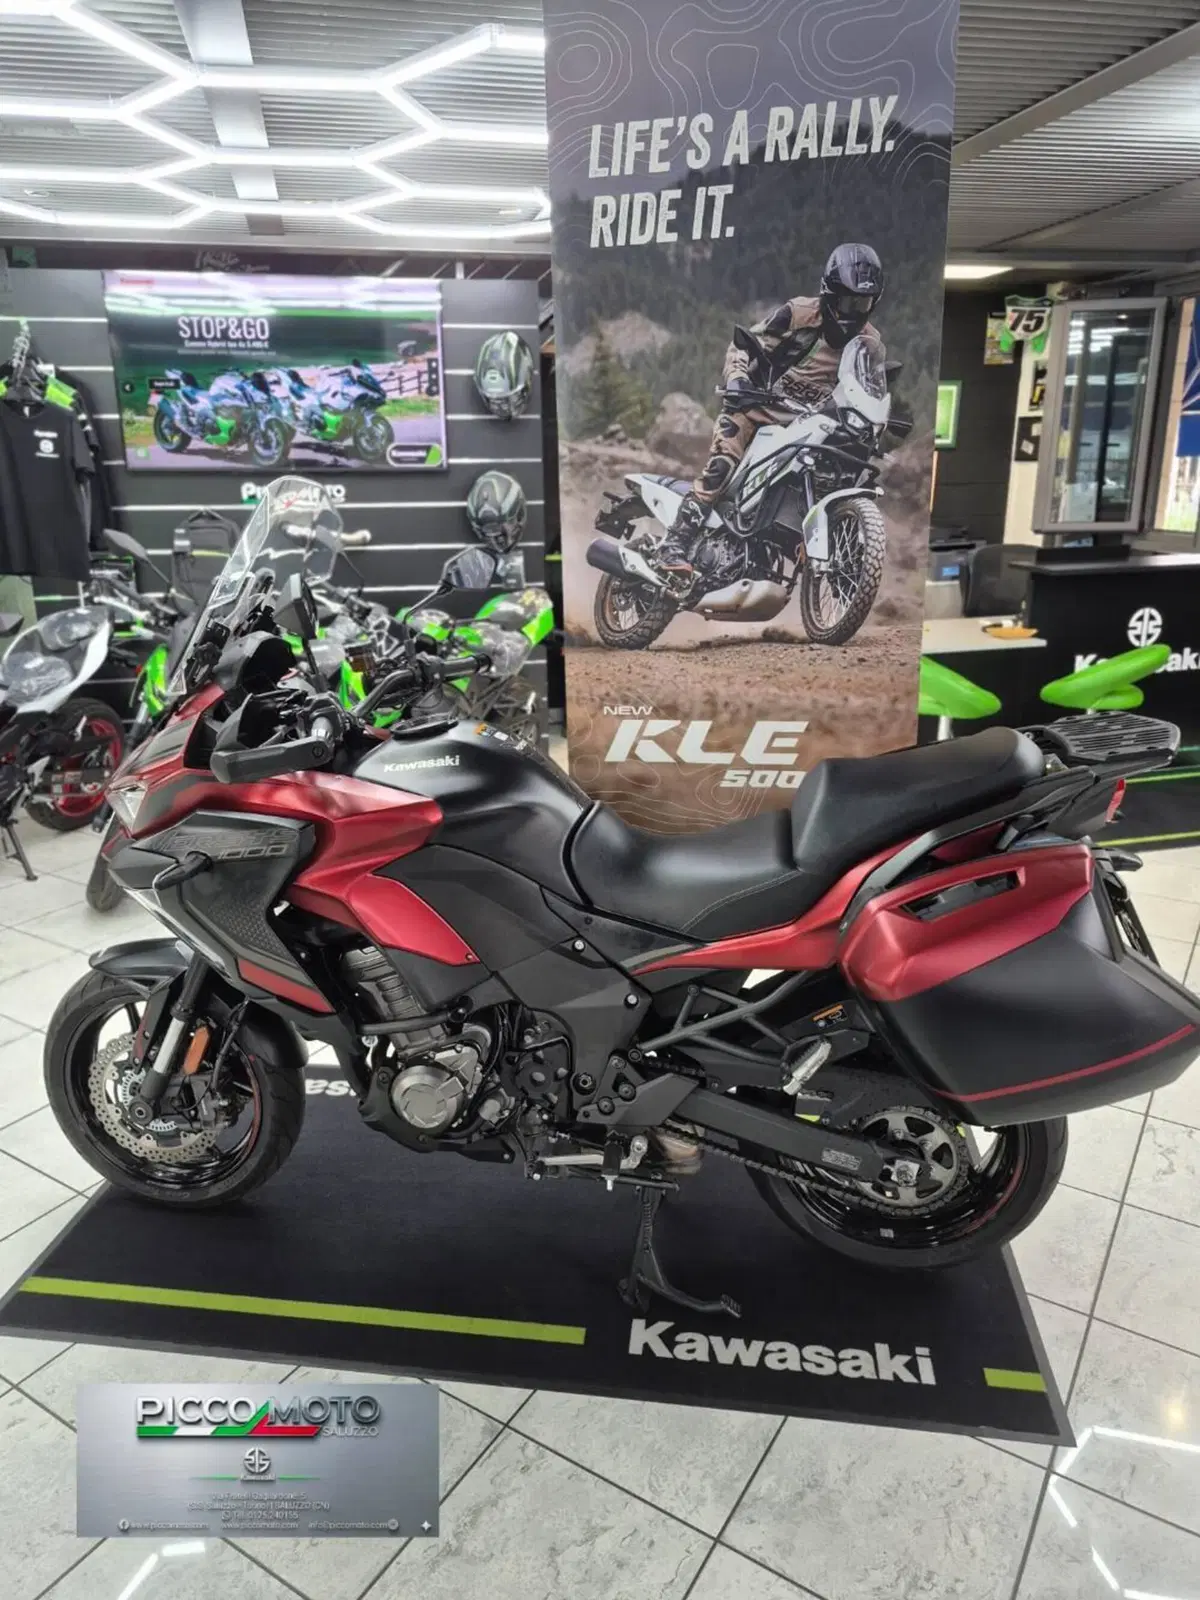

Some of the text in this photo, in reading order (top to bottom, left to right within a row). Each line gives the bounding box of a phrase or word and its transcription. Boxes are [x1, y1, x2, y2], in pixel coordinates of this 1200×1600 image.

[588, 95, 898, 178] LIFE'S A RALLY.
[589, 184, 735, 248] RIDE IT.
[177, 316, 270, 339] STOP&GO
[1009, 308, 1046, 333] 75
[603, 705, 653, 716] NEW
[604, 720, 809, 765] KLE
[383, 755, 461, 772] Kawasaki
[720, 770, 807, 788] 500
[217, 844, 288, 860] 1000
[628, 1318, 937, 1386] Kawasaki
